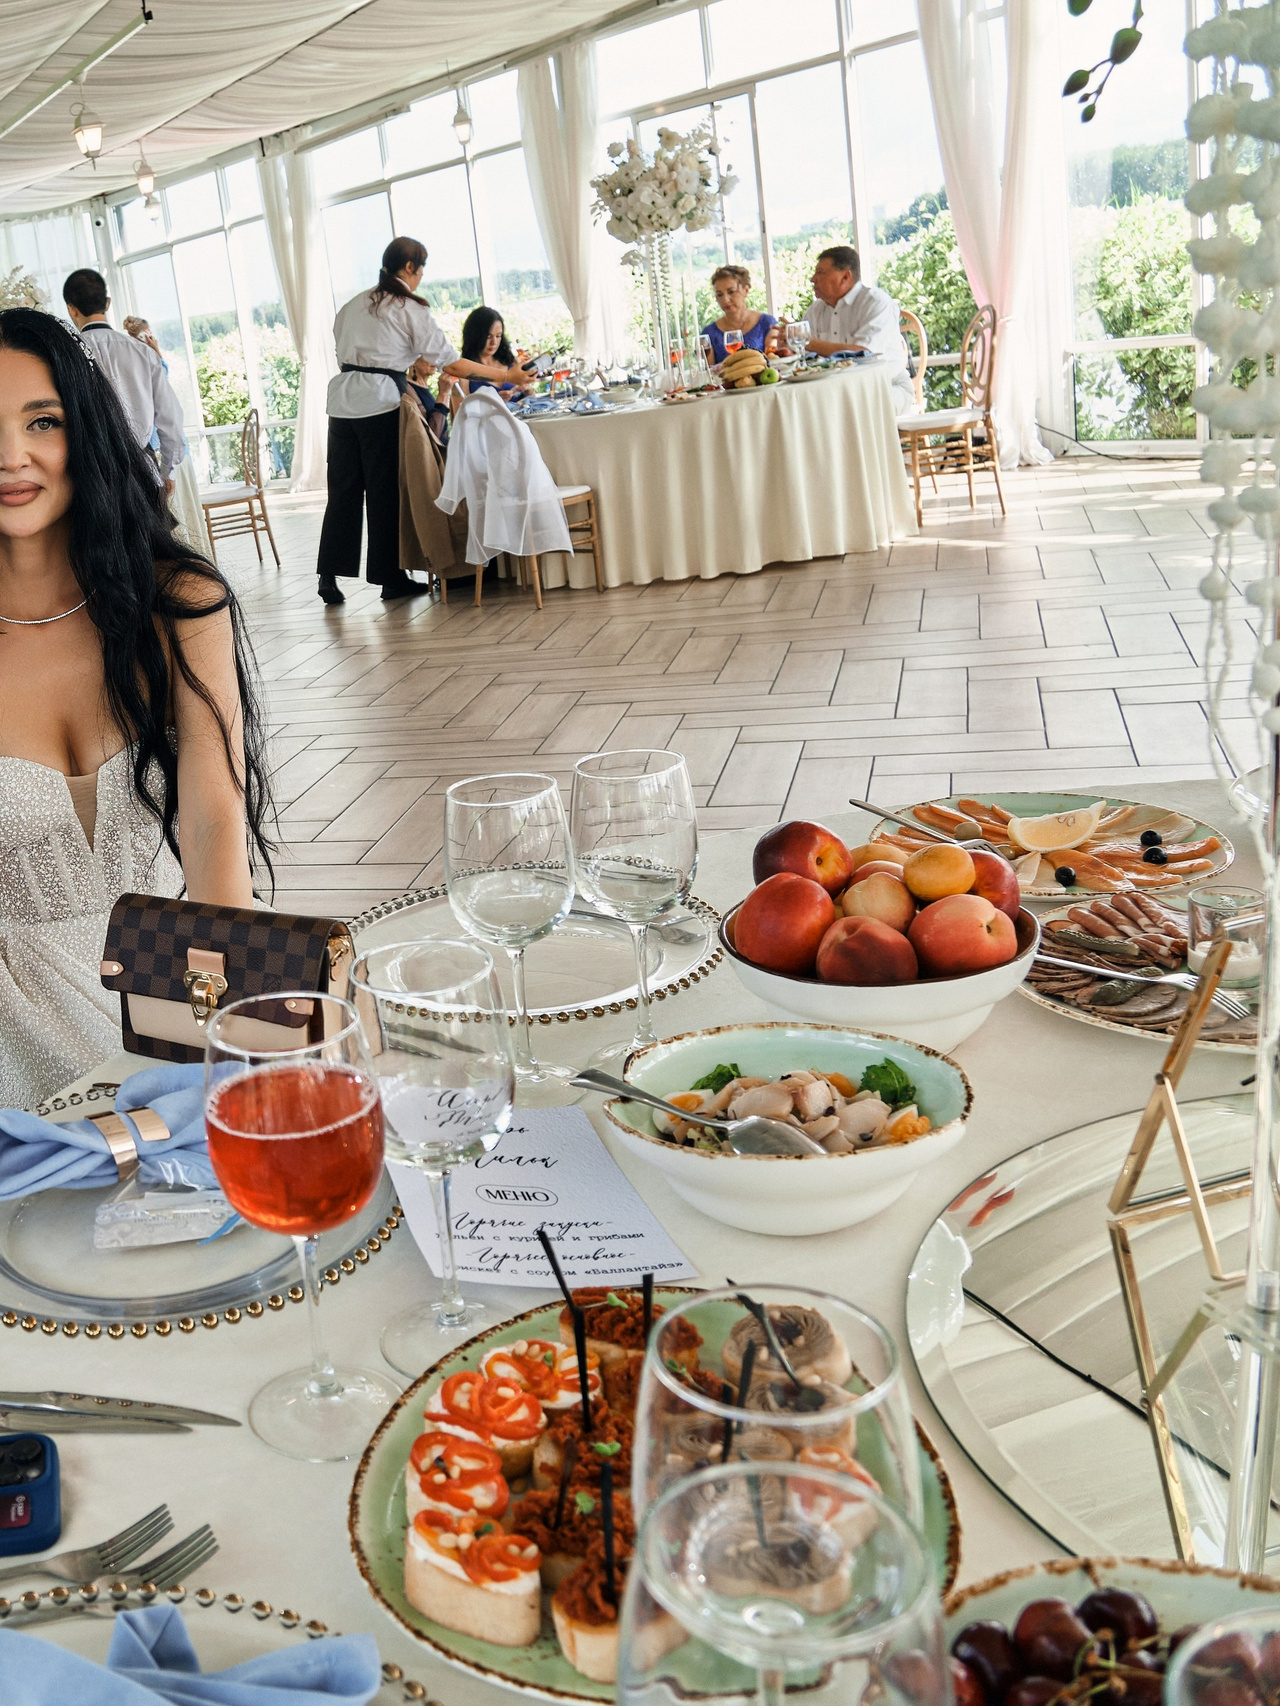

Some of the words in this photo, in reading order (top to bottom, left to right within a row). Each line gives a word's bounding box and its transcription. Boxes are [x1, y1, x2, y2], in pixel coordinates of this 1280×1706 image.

[485, 1188, 550, 1202] МЕНЮ
[451, 1211, 527, 1239] Горячие
[508, 1234, 565, 1243] курией
[588, 1231, 645, 1243] грибами
